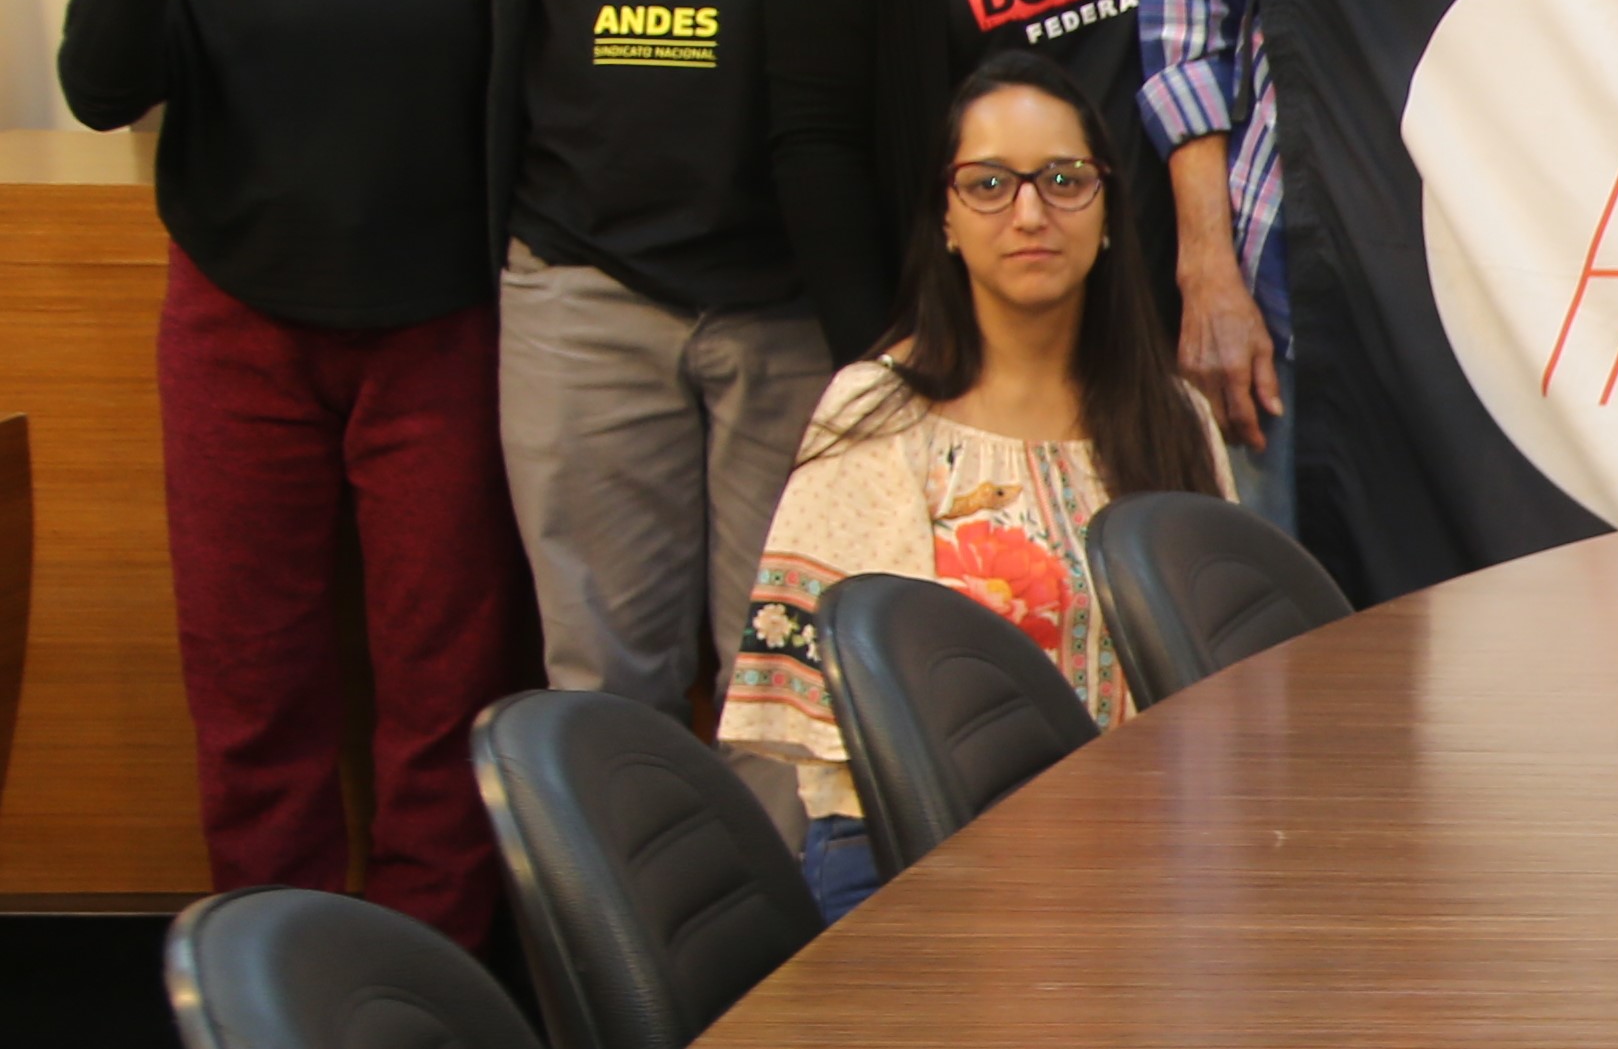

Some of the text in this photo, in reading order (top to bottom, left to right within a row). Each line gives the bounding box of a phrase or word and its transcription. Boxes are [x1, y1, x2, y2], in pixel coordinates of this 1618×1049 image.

[593, 5, 719, 37] ANDES
[594, 45, 717, 61] SINDICATO NACIONAL
